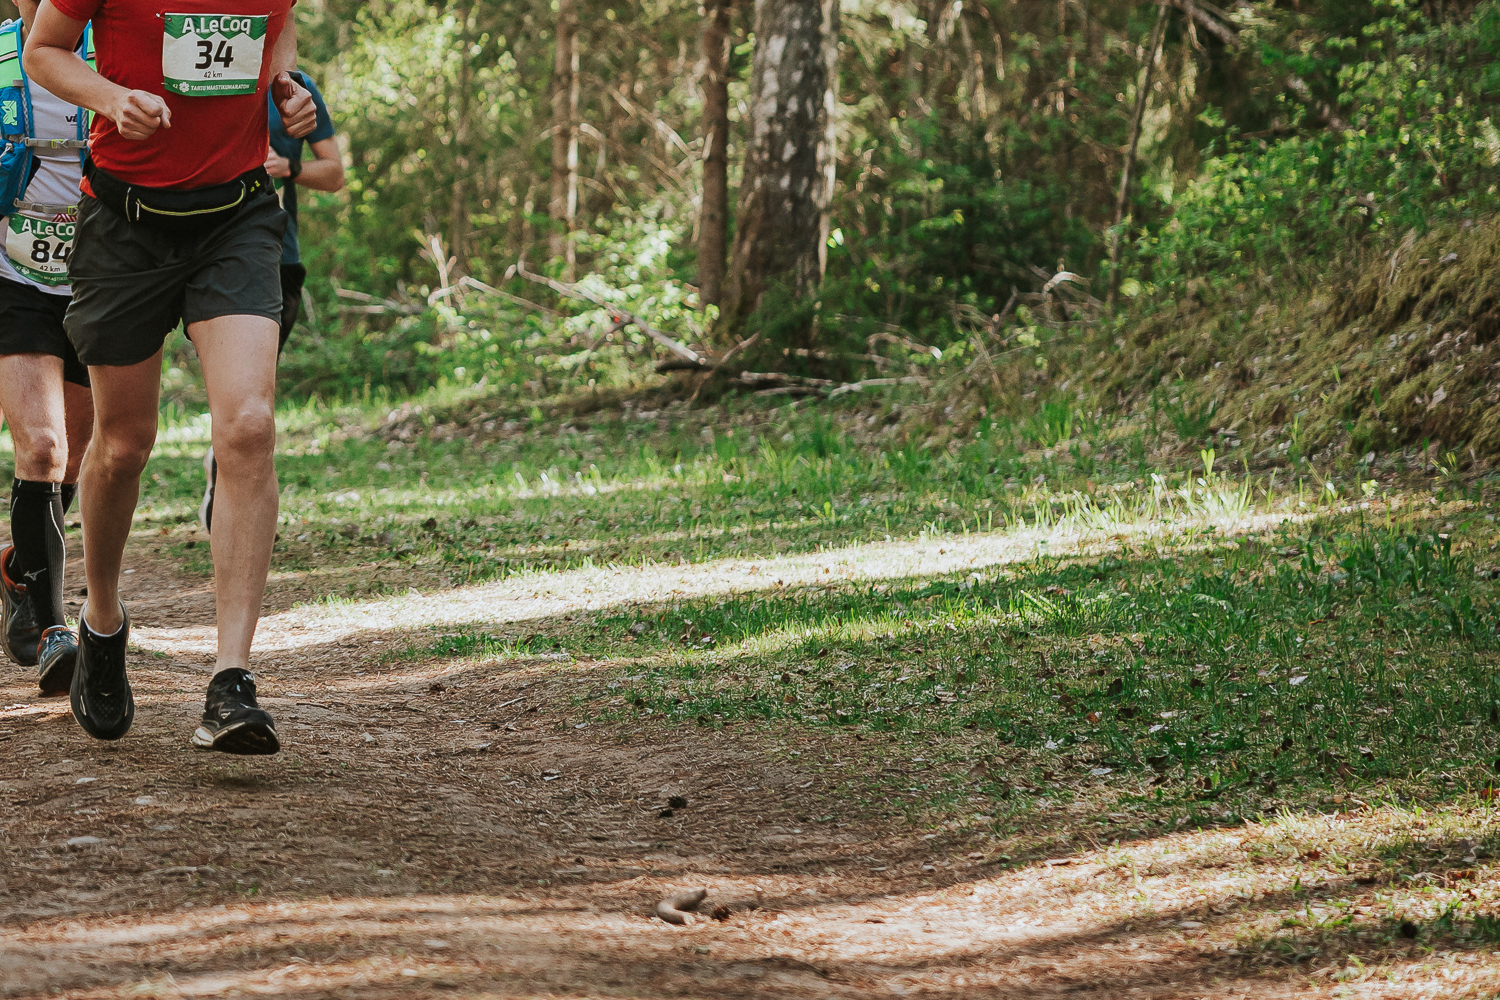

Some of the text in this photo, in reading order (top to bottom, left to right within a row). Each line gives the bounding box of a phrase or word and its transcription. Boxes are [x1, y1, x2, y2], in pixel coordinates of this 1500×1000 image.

[182, 16, 251, 35] A.LeCoq
[195, 40, 234, 69] 34
[21, 218, 76, 236] A.LeCo
[30, 240, 72, 263] 84
